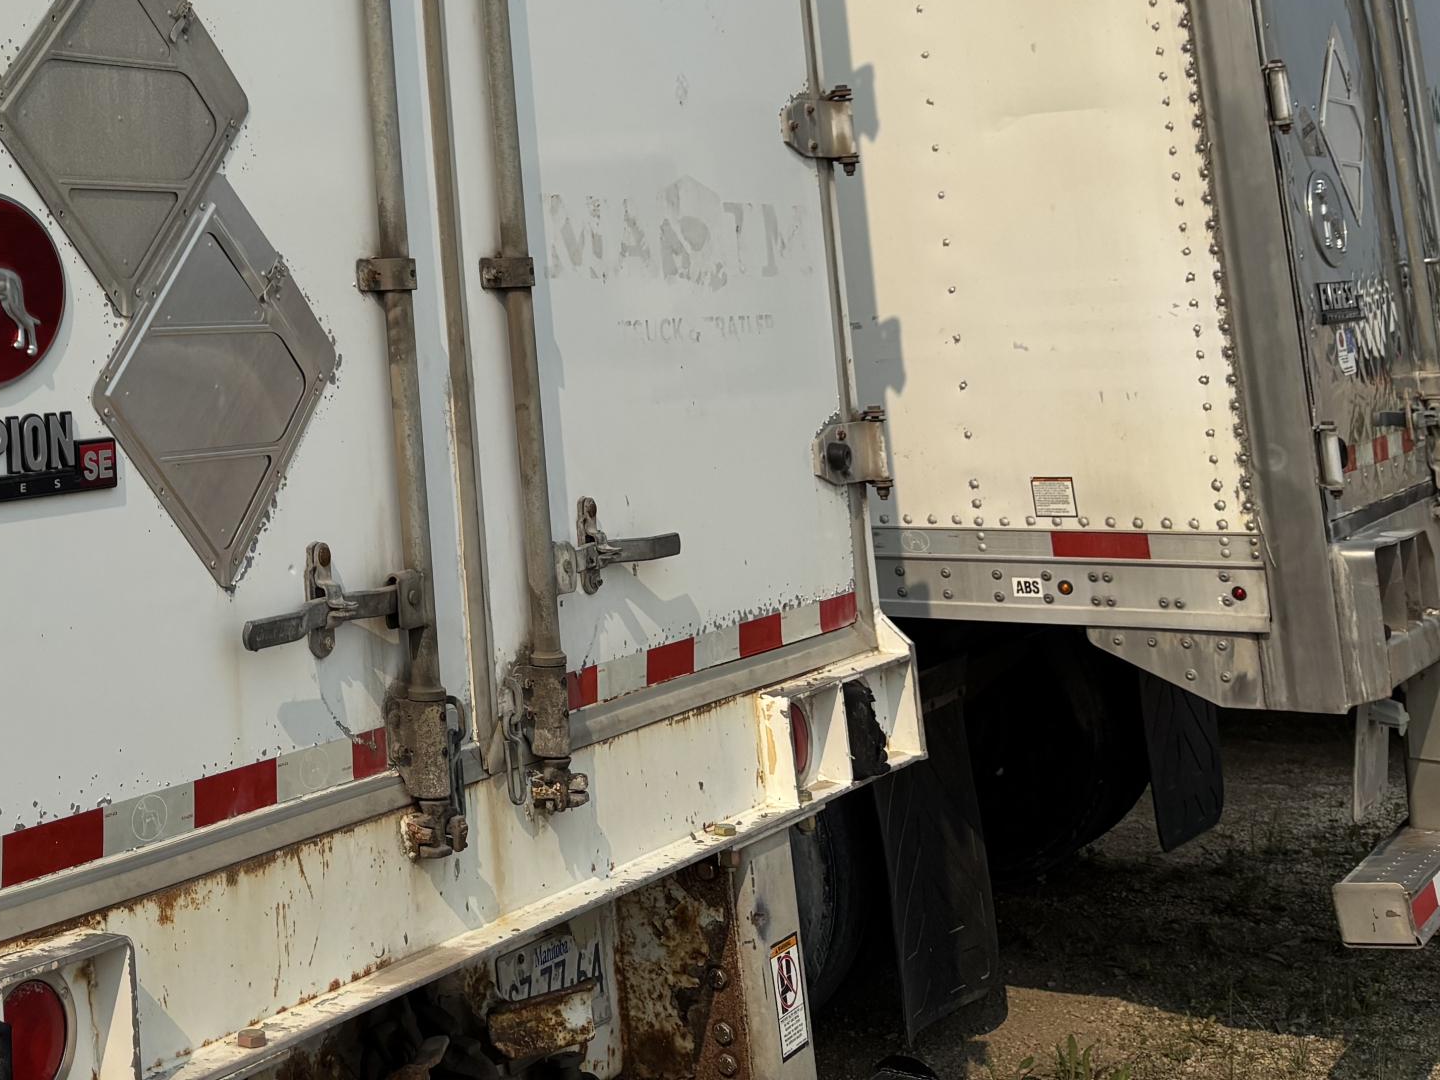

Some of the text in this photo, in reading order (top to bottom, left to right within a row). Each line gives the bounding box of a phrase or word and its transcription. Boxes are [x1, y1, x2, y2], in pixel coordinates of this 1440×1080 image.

[82, 449, 114, 481] SE
[1016, 580, 1040, 594] ABS
[534, 939, 569, 968] Manitoba
